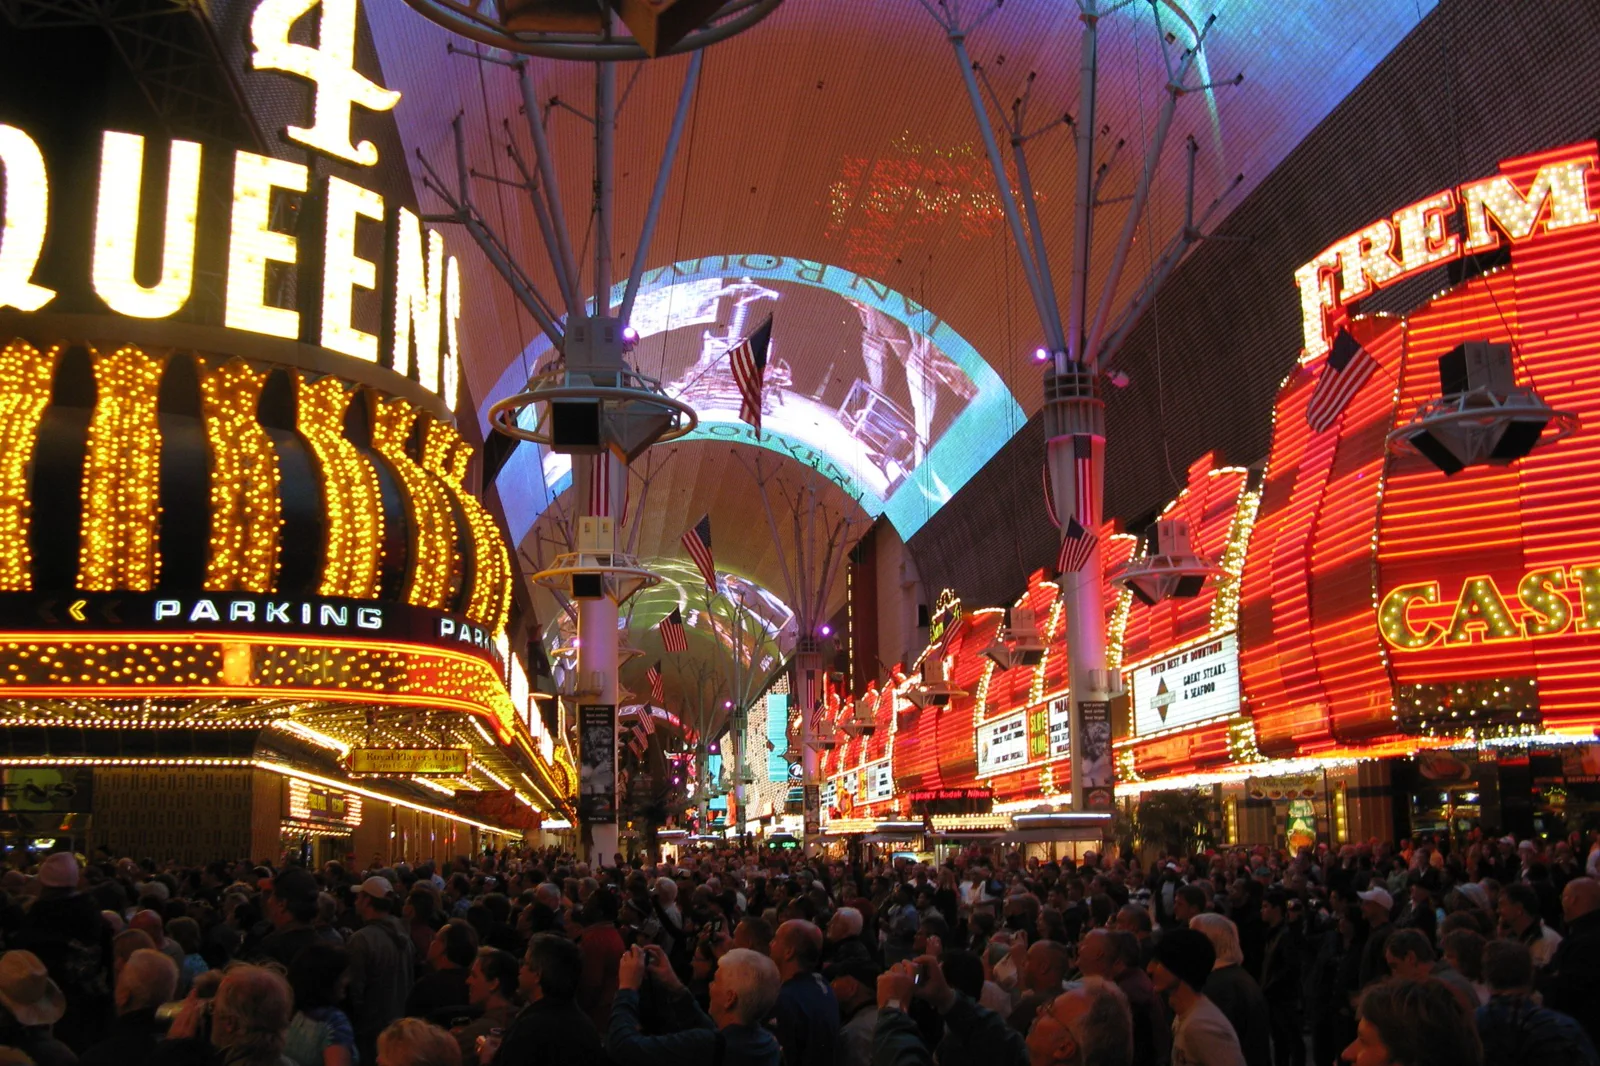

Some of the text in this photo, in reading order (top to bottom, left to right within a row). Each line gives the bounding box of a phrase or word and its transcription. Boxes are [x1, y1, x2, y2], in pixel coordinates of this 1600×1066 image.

[251, 0, 401, 166] 4
[155, 599, 382, 628] PARKING
[1167, 656, 1179, 669] BEST
[1183, 662, 1226, 686] GREAT STEAKS
[1190, 682, 1215, 698] SEAFOOD
[366, 752, 394, 763] Royal
[434, 751, 458, 761] Club
[940, 790, 962, 799] Kodak
[966, 789, 990, 798] Nikon
